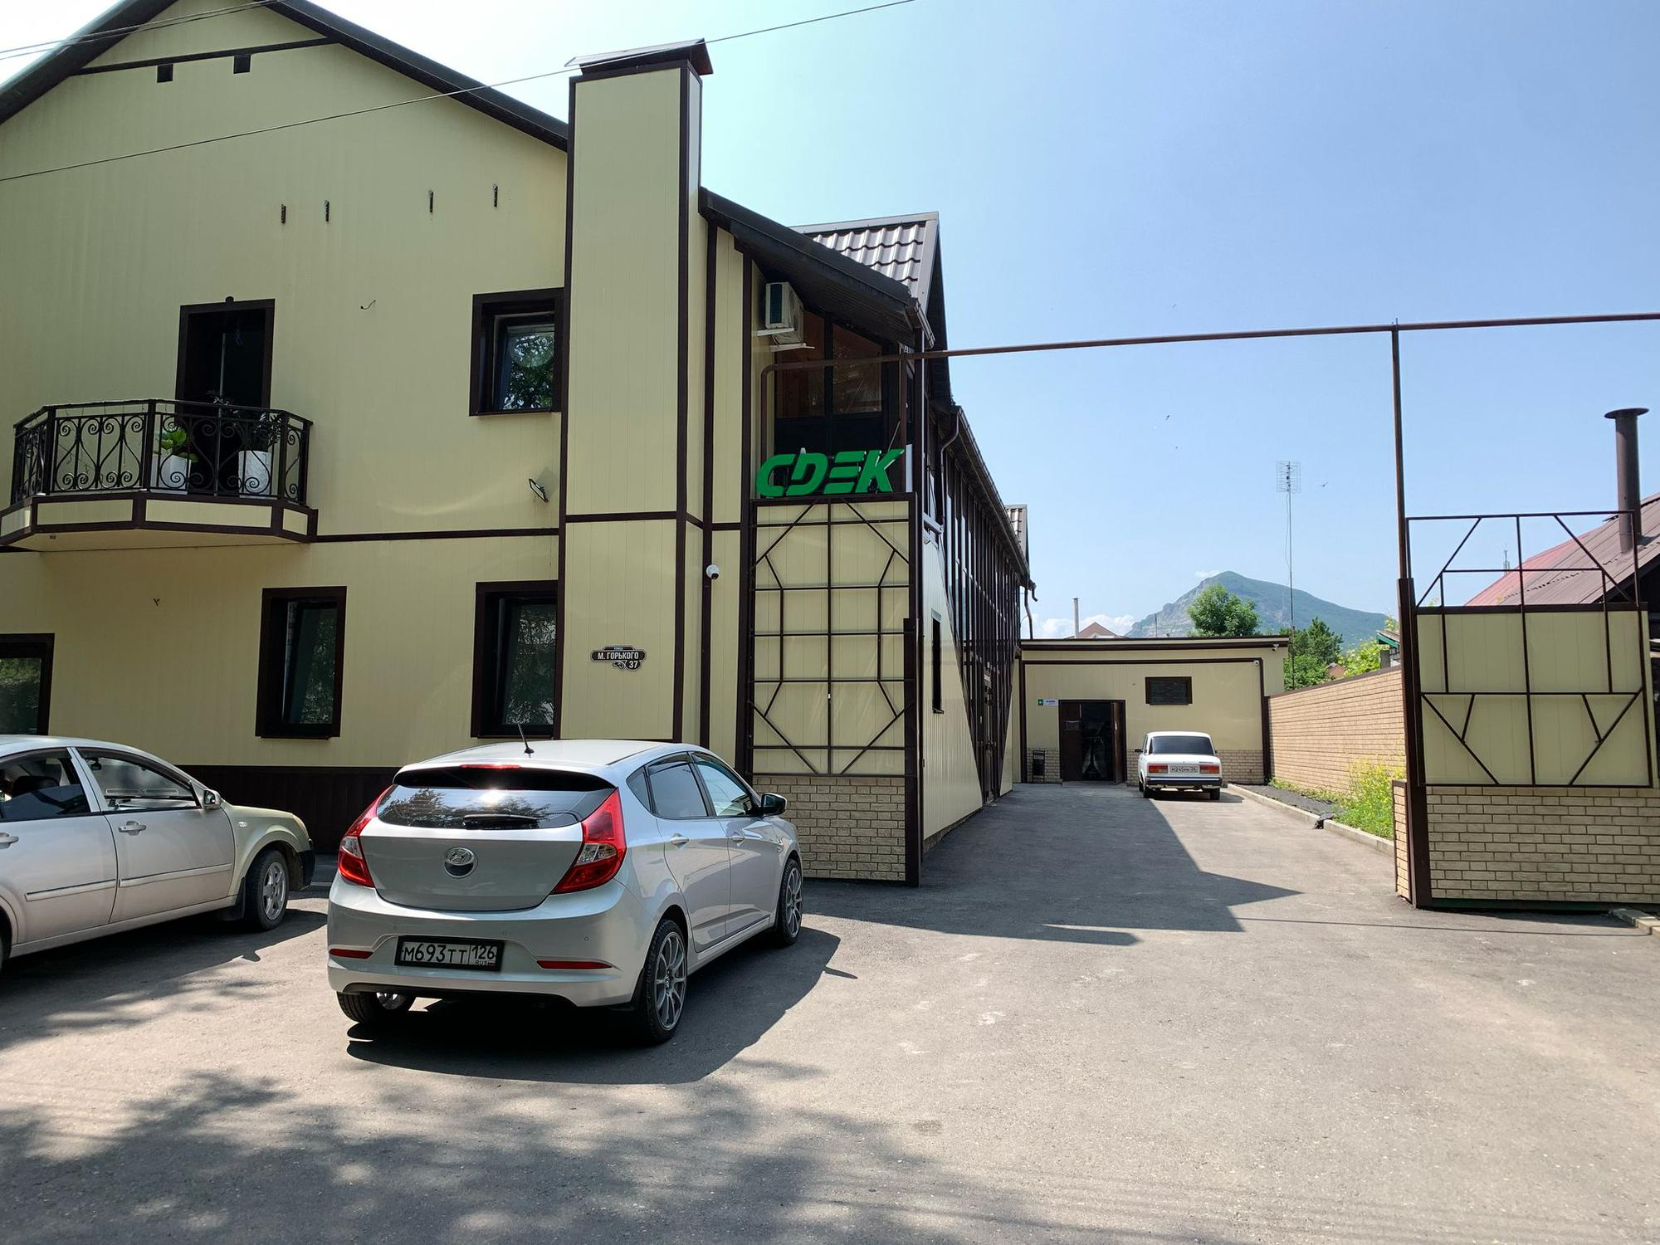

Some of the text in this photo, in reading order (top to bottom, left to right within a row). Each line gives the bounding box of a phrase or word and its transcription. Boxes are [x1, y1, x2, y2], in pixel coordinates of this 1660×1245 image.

[756, 448, 905, 497] CDEK
[597, 651, 639, 660] М. ГОРЬКОГО
[628, 660, 638, 669] 37
[403, 943, 496, 965] М693ТТ 126
